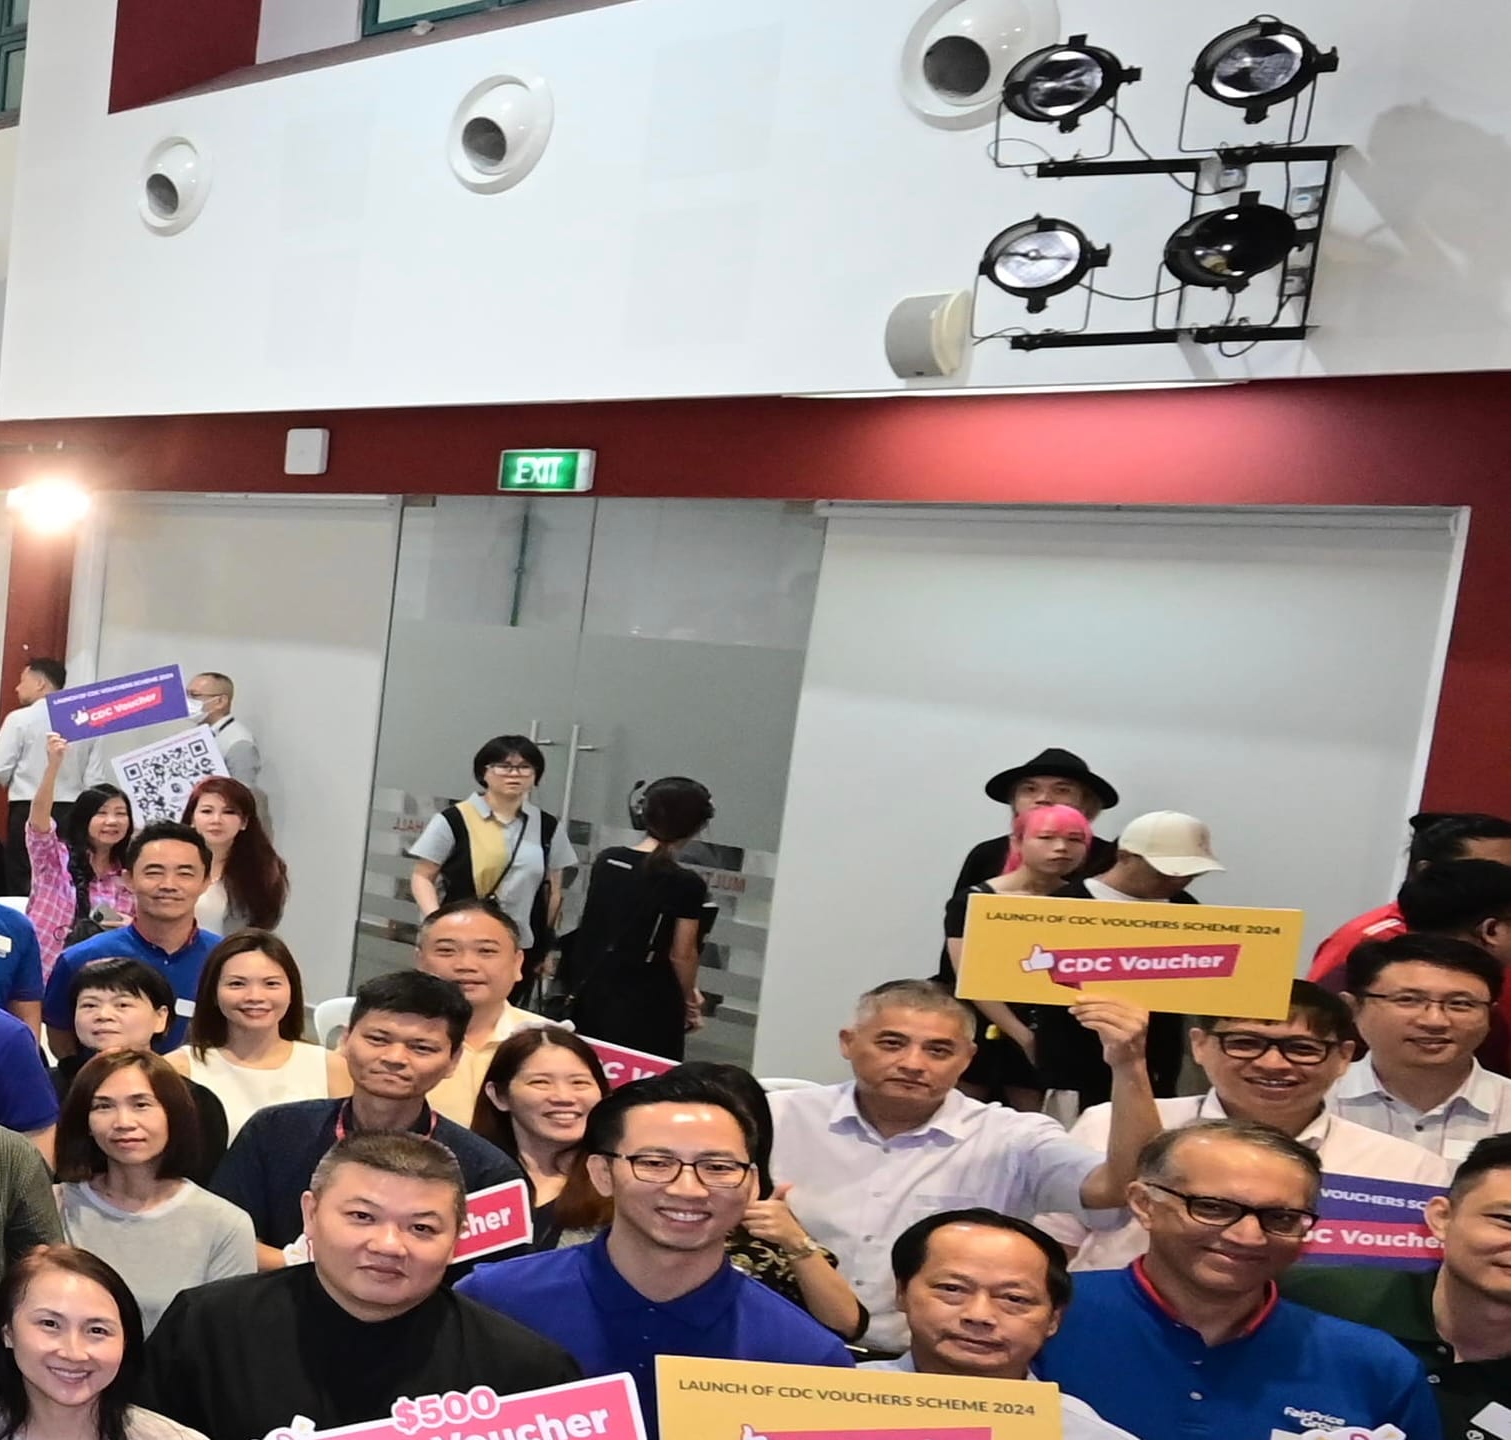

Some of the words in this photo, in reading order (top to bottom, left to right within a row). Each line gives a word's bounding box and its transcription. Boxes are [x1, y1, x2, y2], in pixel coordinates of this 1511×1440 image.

[516, 457, 563, 484] EXIT
[90, 709, 114, 721] CDC
[116, 693, 157, 713] Voucher
[986, 911, 1044, 922] LAUNCH
[1046, 914, 1065, 923] OF
[1067, 916, 1093, 926] CDC
[1100, 918, 1179, 930] VOUCHERS
[1182, 922, 1243, 933] SCHEME
[1246, 925, 1281, 935] 2024
[1058, 957, 1112, 973] CDC
[1119, 952, 1225, 971] Voucher
[1320, 1188, 1405, 1208] VOUCHERS
[392, 1388, 498, 1431] $500
[679, 1379, 748, 1395] LAUNCH
[752, 1384, 774, 1396] OF
[778, 1386, 813, 1400] CDC
[817, 1388, 912, 1407] VOUCHERS
[916, 1396, 988, 1413] SCHEME
[993, 1402, 1035, 1416] 2024
[1283, 1406, 1346, 1426] FairPrice
